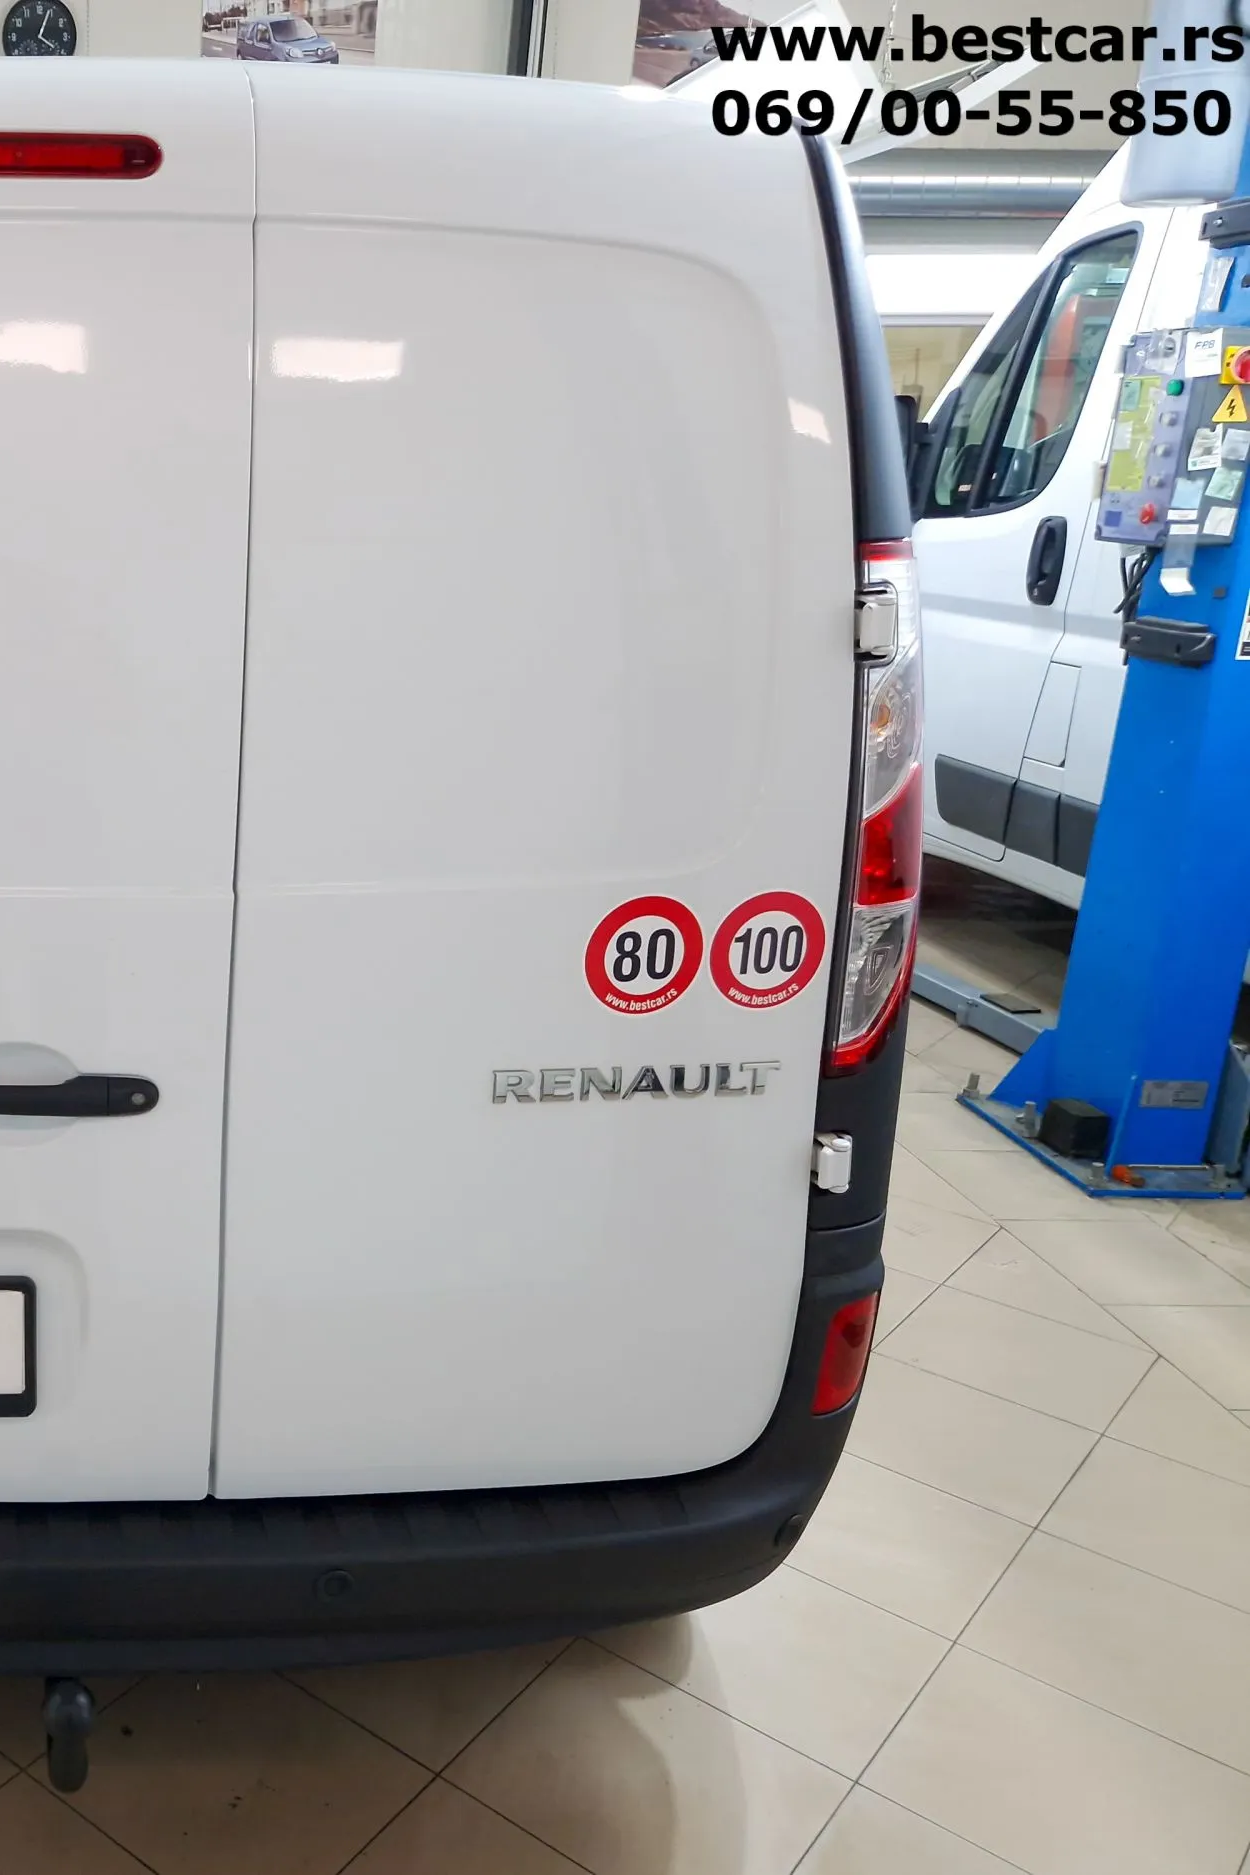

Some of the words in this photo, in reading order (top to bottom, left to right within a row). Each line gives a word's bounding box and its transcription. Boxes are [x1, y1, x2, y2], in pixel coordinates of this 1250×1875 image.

[612, 928, 676, 983] 80
[734, 924, 805, 976] 100
[604, 986, 679, 1012] www.bestcar.rs
[727, 981, 800, 1006] www.bestcar.rs
[492, 1060, 782, 1104] RENAULT
